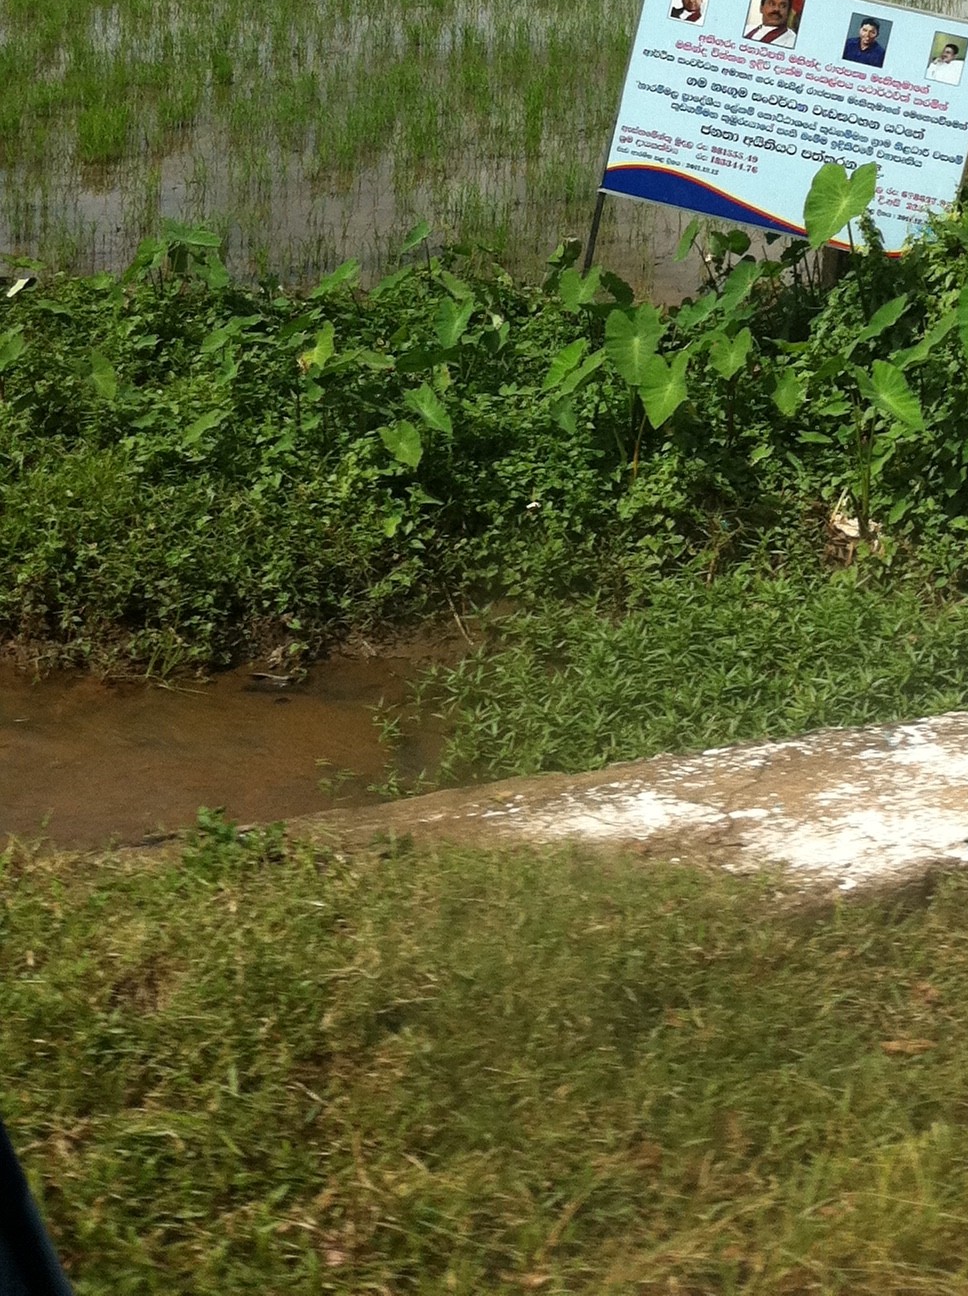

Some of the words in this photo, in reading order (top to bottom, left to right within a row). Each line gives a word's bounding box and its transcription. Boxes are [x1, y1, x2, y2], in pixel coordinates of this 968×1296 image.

[675, 40, 707, 57] මහින්ද
[711, 48, 746, 64] චින්තන
[773, 65, 802, 77] දැක්ම
[913, 98, 949, 111] කරමින්
[678, 57, 719, 72] සංවර්ධන
[777, 80, 804, 94] බැසිල්
[806, 87, 844, 102] රාජපක්ෂ
[788, 55, 821, 71] මහින්ද
[825, 63, 867, 80] රාජපක්ෂ
[870, 74, 931, 94] මැතිතුමාගේ
[671, 103, 718, 119] කුඩගම්මන
[687, 77, 707, 88] ගම
[711, 83, 748, 98] නැගුම
[752, 93, 808, 113] සංවර්ධන
[812, 105, 880, 130] වැඩසටහන
[884, 124, 926, 140] යටතේ
[701, 125, 739, 142] ජනතා
[724, 104, 755, 116] ලේකම්
[820, 126, 868, 142] කුඩගම්මන
[871, 139, 891, 148] ග්‍රාම
[932, 151, 963, 165] වසමේ
